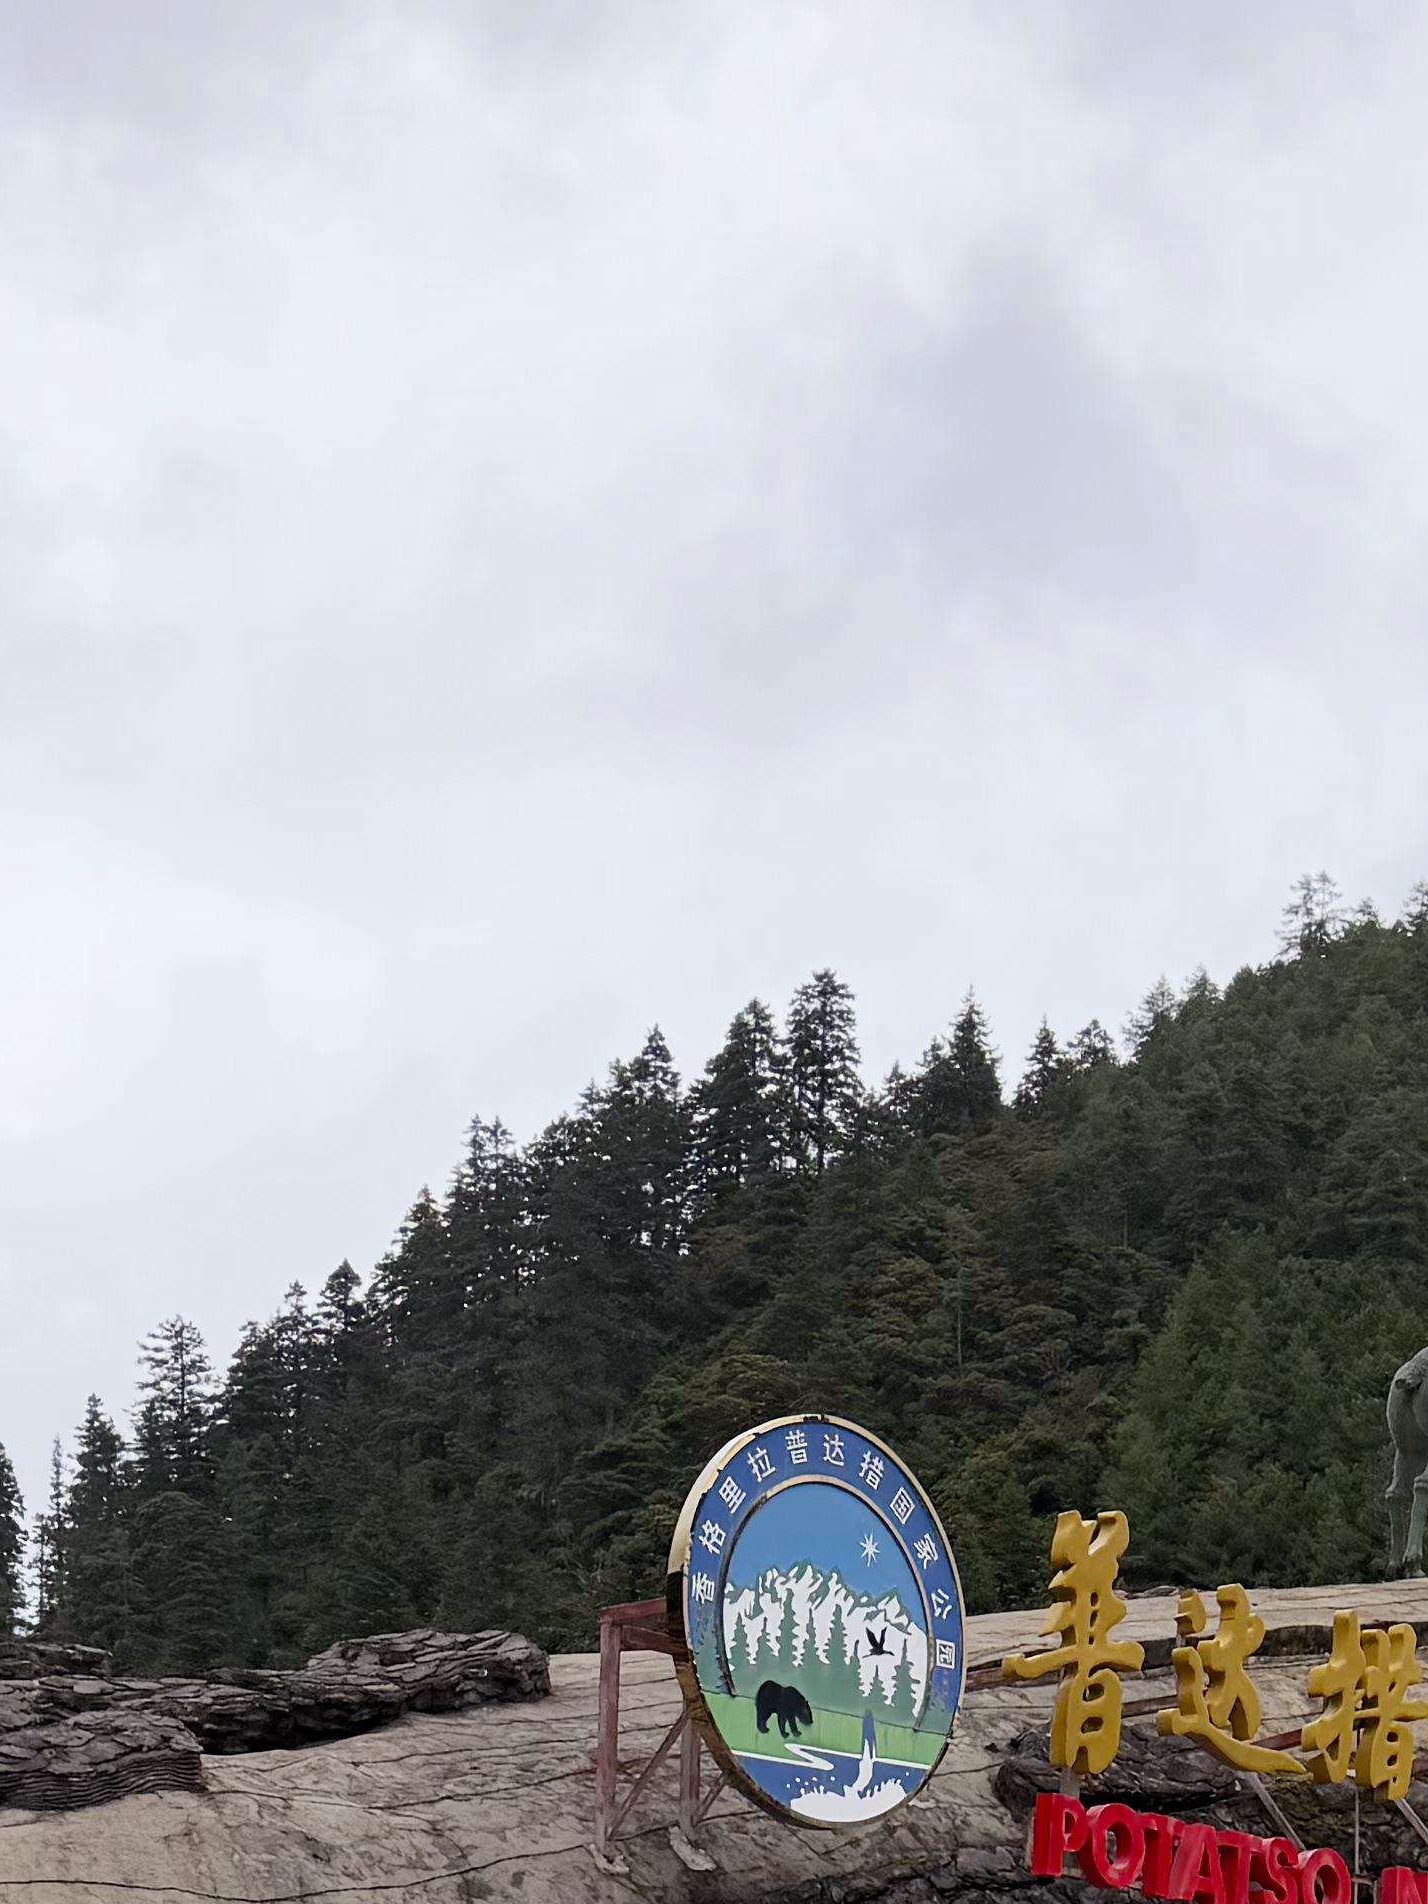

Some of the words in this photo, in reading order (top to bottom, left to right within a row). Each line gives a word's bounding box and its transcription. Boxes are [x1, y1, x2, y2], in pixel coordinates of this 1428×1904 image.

[690, 1429, 956, 1671] 香格里拉普达措国家公园
